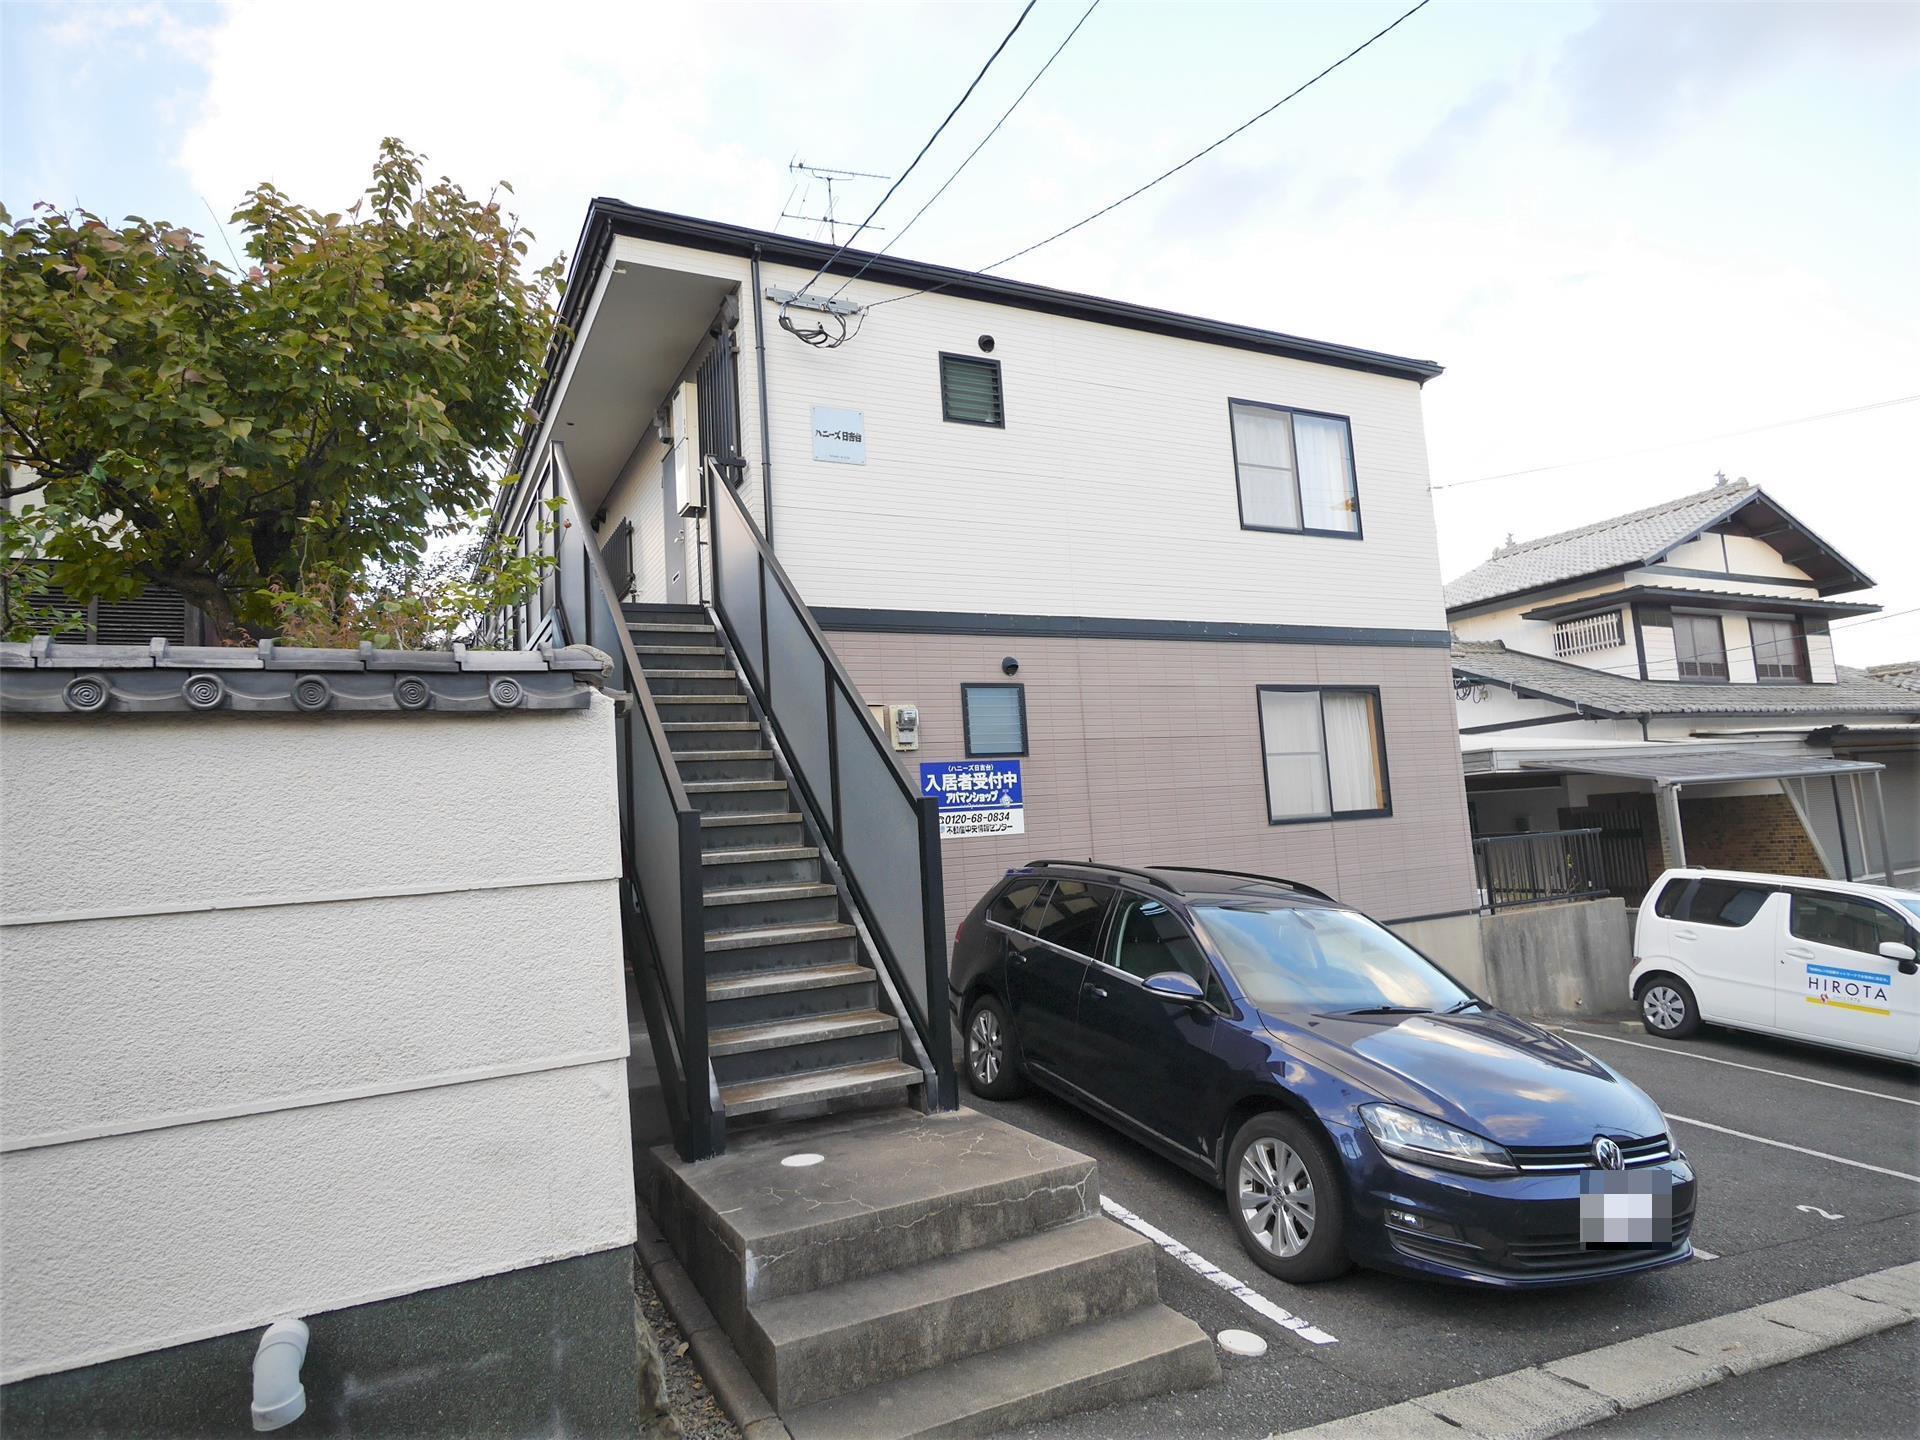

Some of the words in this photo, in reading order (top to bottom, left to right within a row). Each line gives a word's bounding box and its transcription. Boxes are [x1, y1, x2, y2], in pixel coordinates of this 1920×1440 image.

[925, 771, 1017, 792] 入居者受付中
[946, 790, 998, 804] アパマンショップ
[945, 812, 1010, 824] 0120-68-0834
[1808, 977, 1888, 1002] HIROTA
